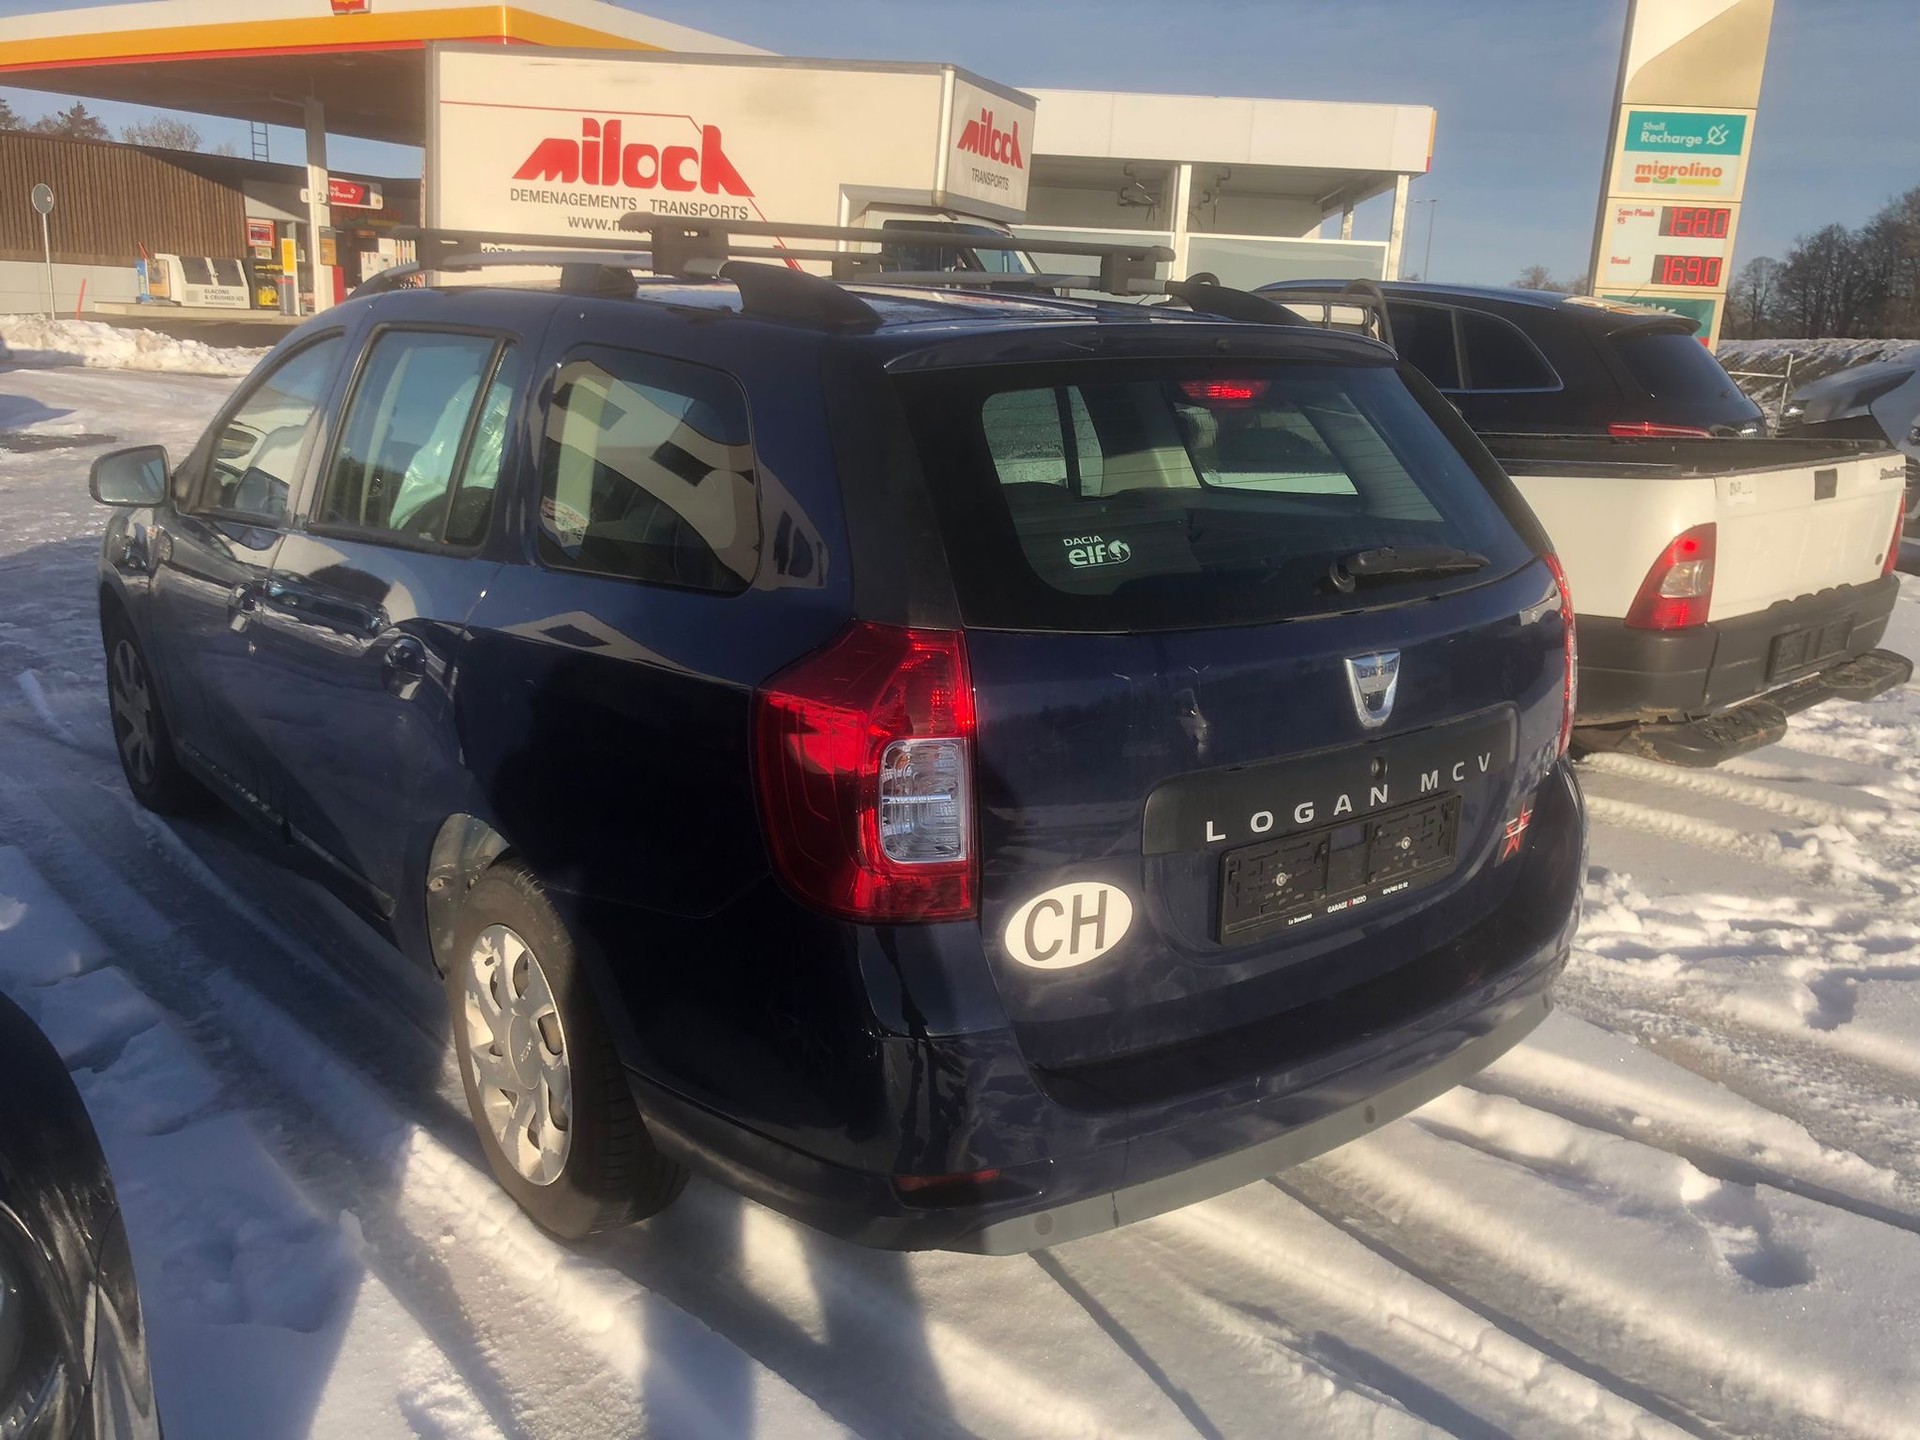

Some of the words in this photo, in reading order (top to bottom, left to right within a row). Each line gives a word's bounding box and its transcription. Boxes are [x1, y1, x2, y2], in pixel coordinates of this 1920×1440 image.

[1642, 122, 1666, 131] Shell
[957, 107, 1023, 169] milock
[1640, 131, 1702, 147] Recharge
[512, 117, 756, 198] milock
[971, 168, 1010, 191] TRANSPORTS
[1635, 160, 1723, 179] migrolino
[510, 188, 638, 211] DEMENAGEMENTS
[650, 198, 749, 220] TRANSPORTS
[1611, 256, 1631, 264] Diesel
[1063, 535, 1103, 546] DACIA
[1068, 544, 1107, 566] elf
[1206, 784, 1389, 842] LOGAN
[1420, 752, 1491, 793] MCV
[1327, 900, 1348, 914] GARAGE
[1024, 889, 1108, 961] CH
